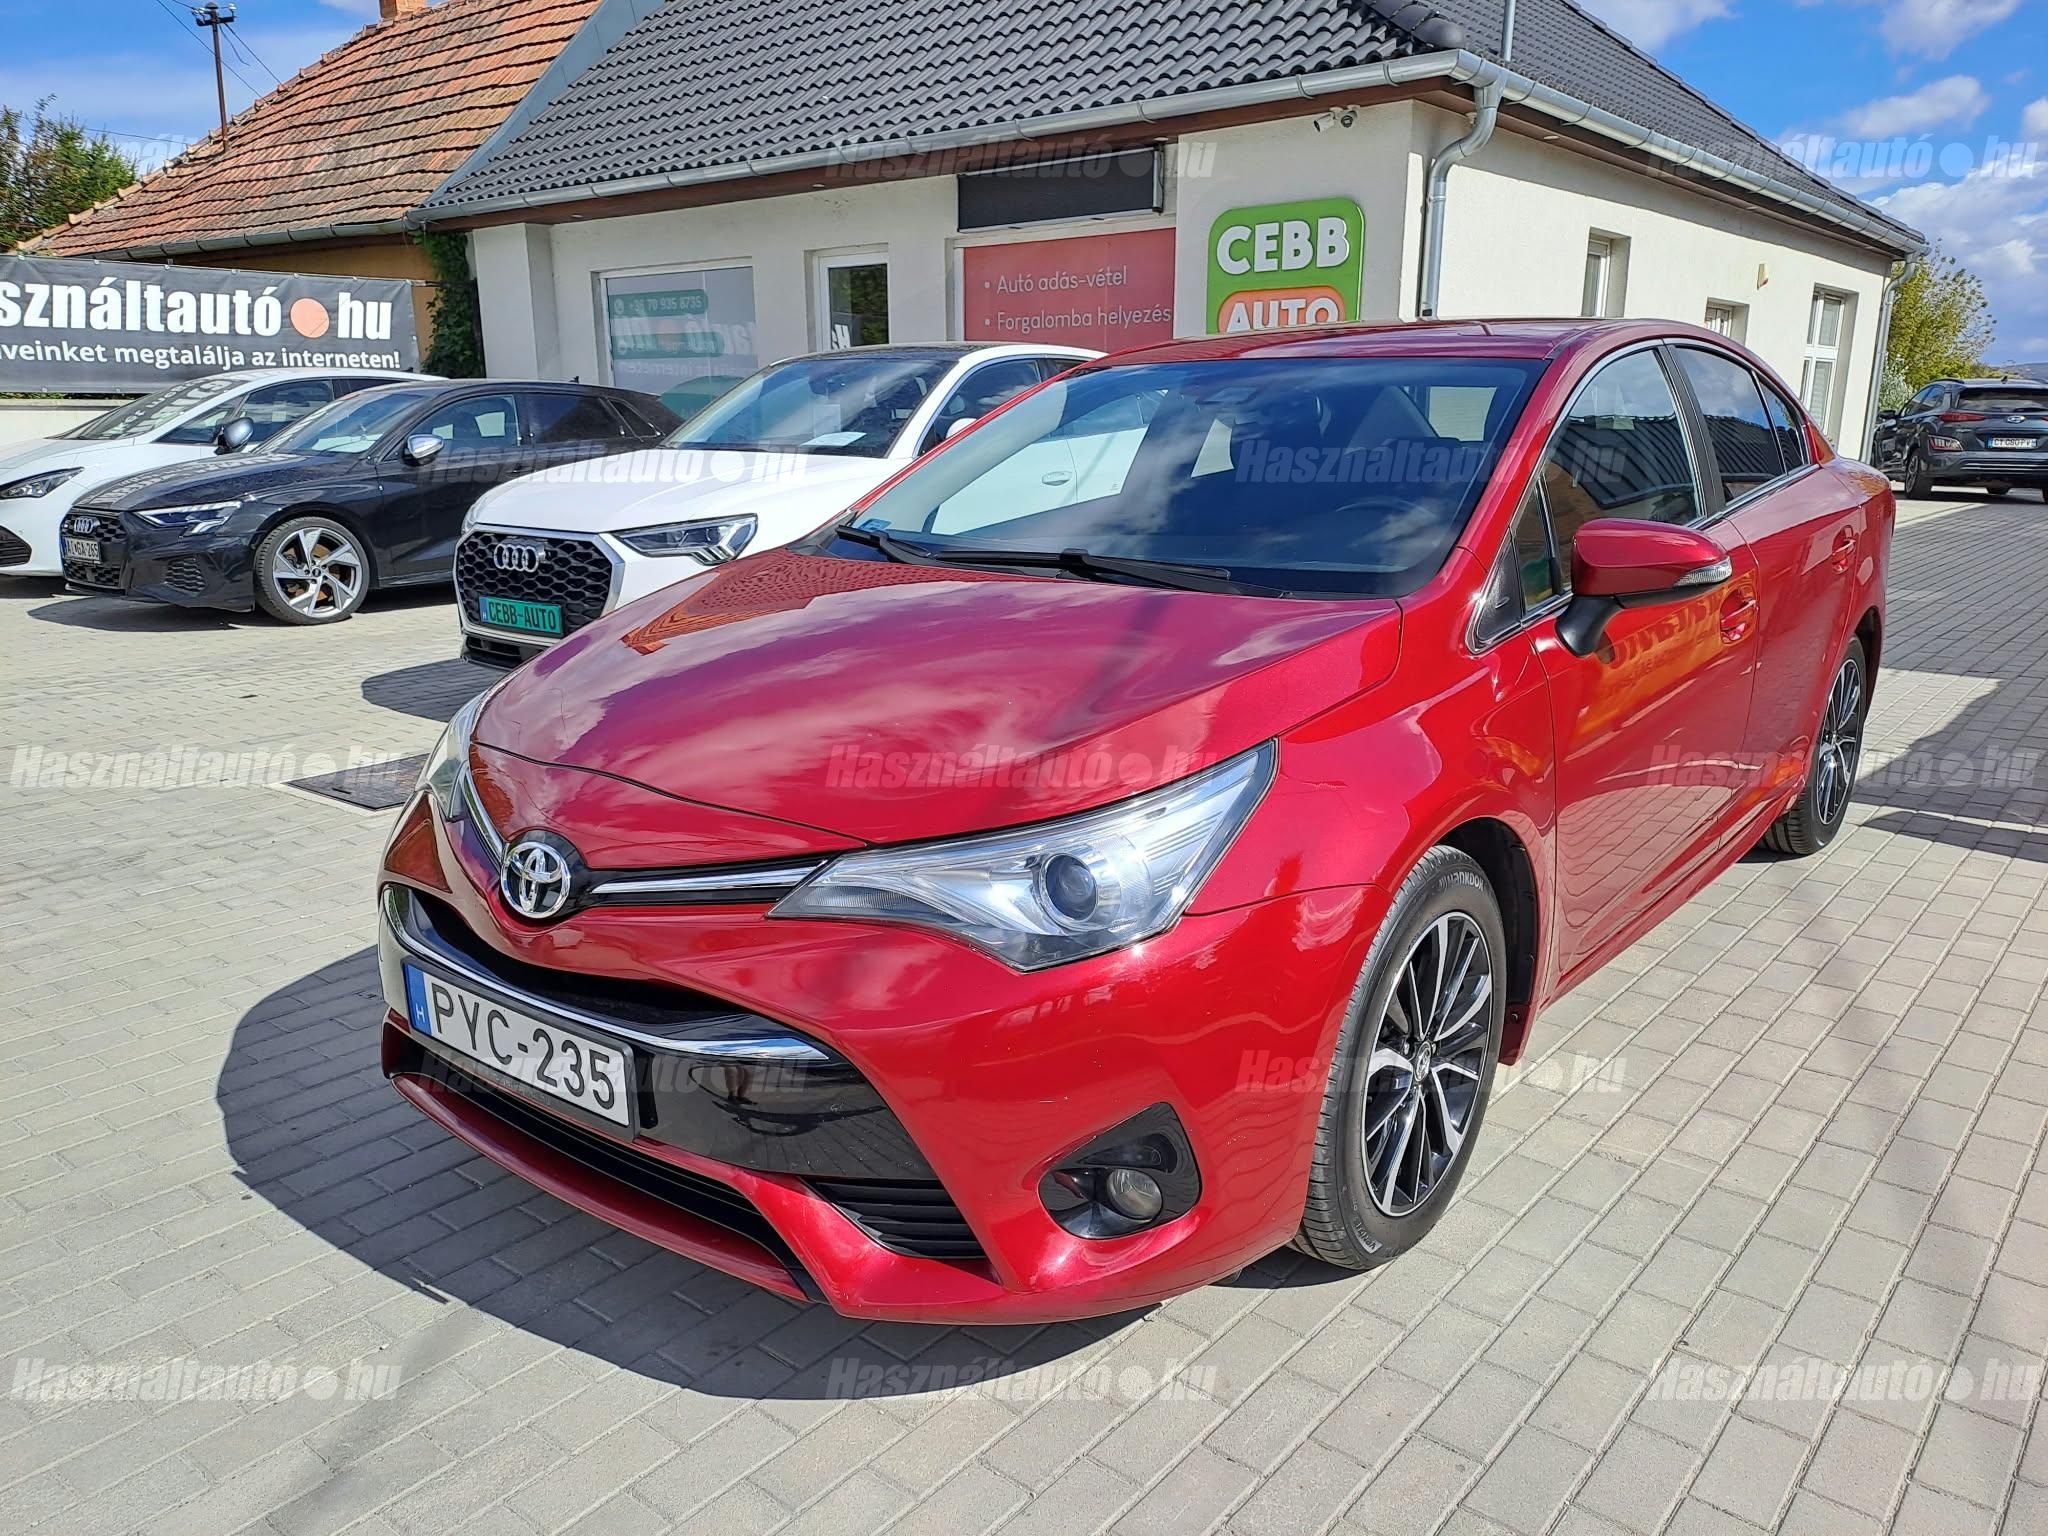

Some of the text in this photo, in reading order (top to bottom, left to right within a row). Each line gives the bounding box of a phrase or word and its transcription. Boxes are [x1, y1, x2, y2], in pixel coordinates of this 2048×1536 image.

[1217, 217, 1349, 275] CEBB
[997, 265, 1127, 294] Autó adás-vétel
[997, 304, 1172, 334] Forgalomba helyezés
[1226, 298, 1338, 333] AUTO
[0, 340, 401, 370] veinket megtalálja az interneten!
[488, 601, 556, 630] CEBB-AUTO
[415, 1005, 425, 1023] H
[431, 983, 615, 1110] PYC-235
